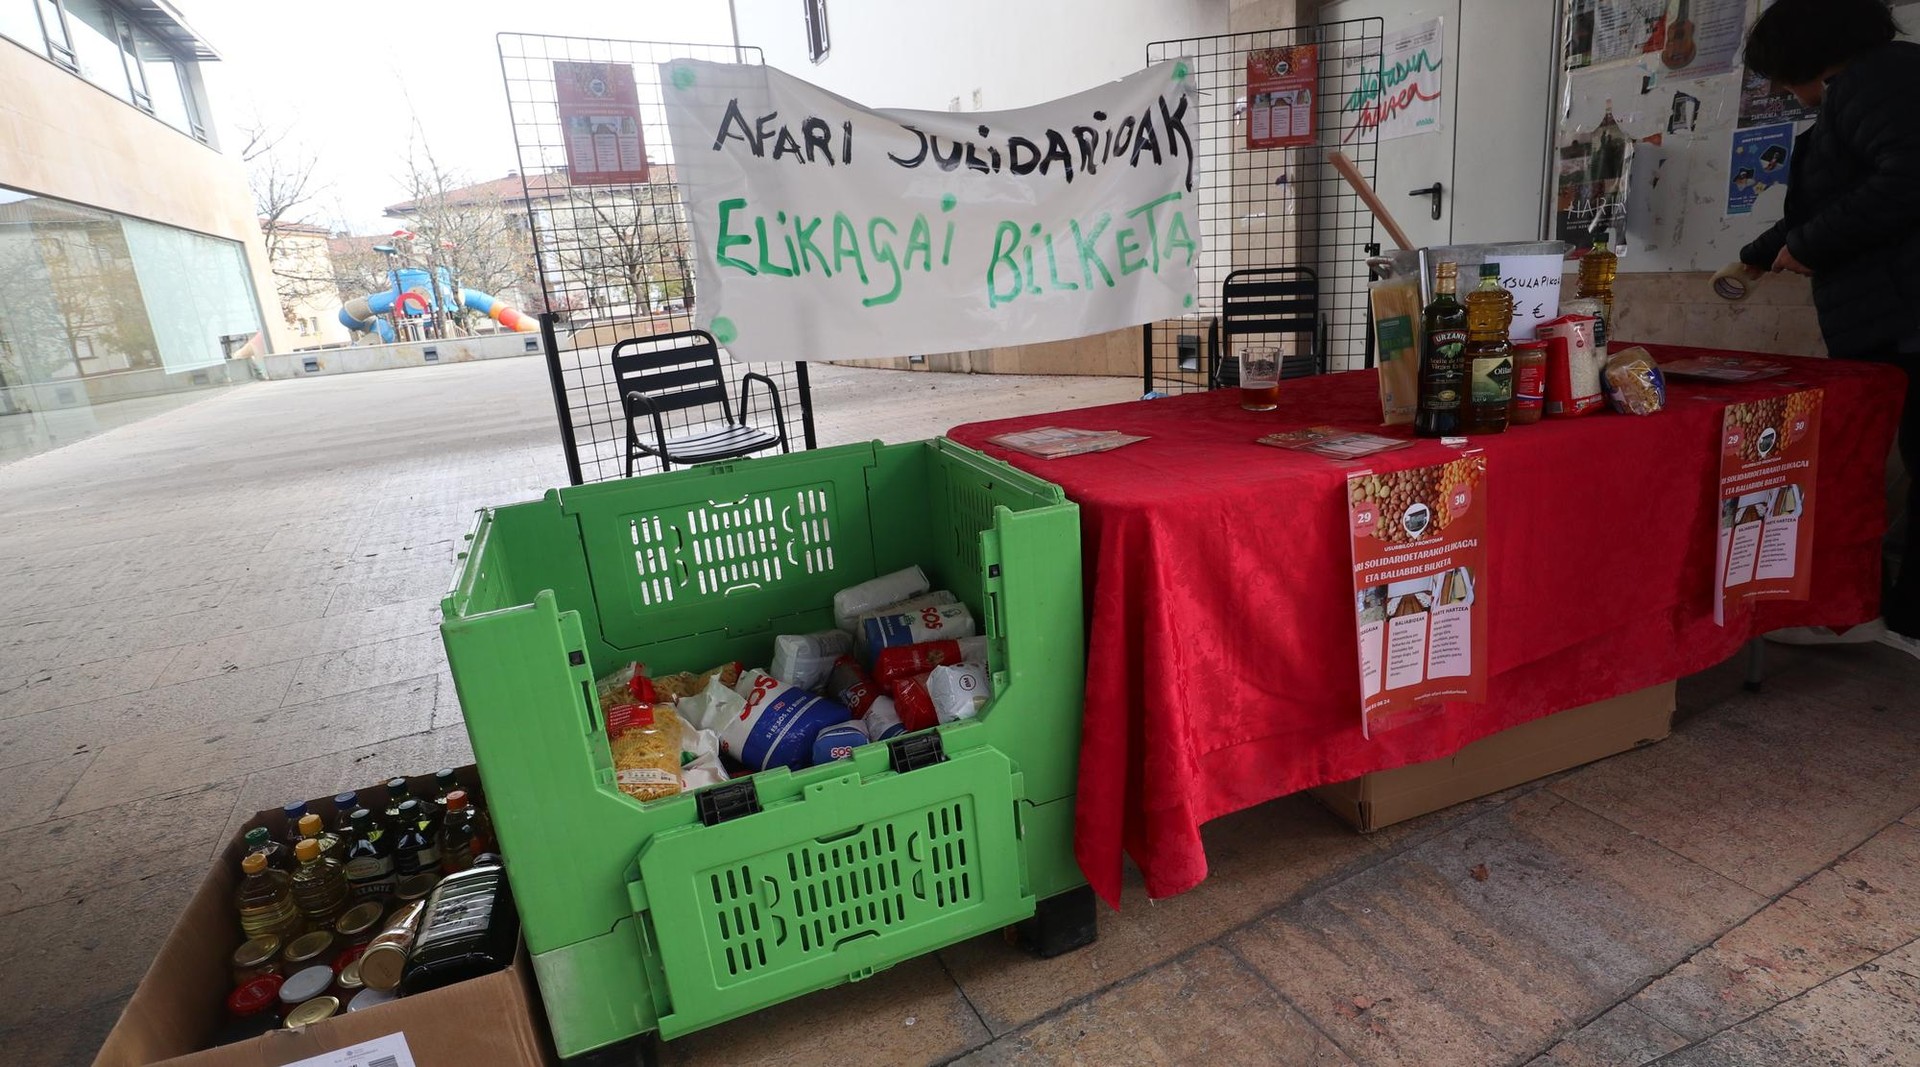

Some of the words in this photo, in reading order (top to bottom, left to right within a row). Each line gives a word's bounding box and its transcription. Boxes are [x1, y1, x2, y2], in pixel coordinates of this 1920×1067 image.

[712, 98, 852, 166] AFARI
[1728, 435, 1739, 445] 29
[1454, 494, 1465, 506] 30
[1357, 512, 1371, 524] 29
[1364, 544, 1444, 570] SOLIDARIOETARAKO
[1444, 538, 1478, 553] ELIKAGAI
[1365, 573, 1379, 583] ETA
[1380, 564, 1424, 580] BALIABIDE
[1424, 557, 1451, 572] BILKETA
[920, 607, 943, 630] SOS
[831, 746, 853, 759] SOS
